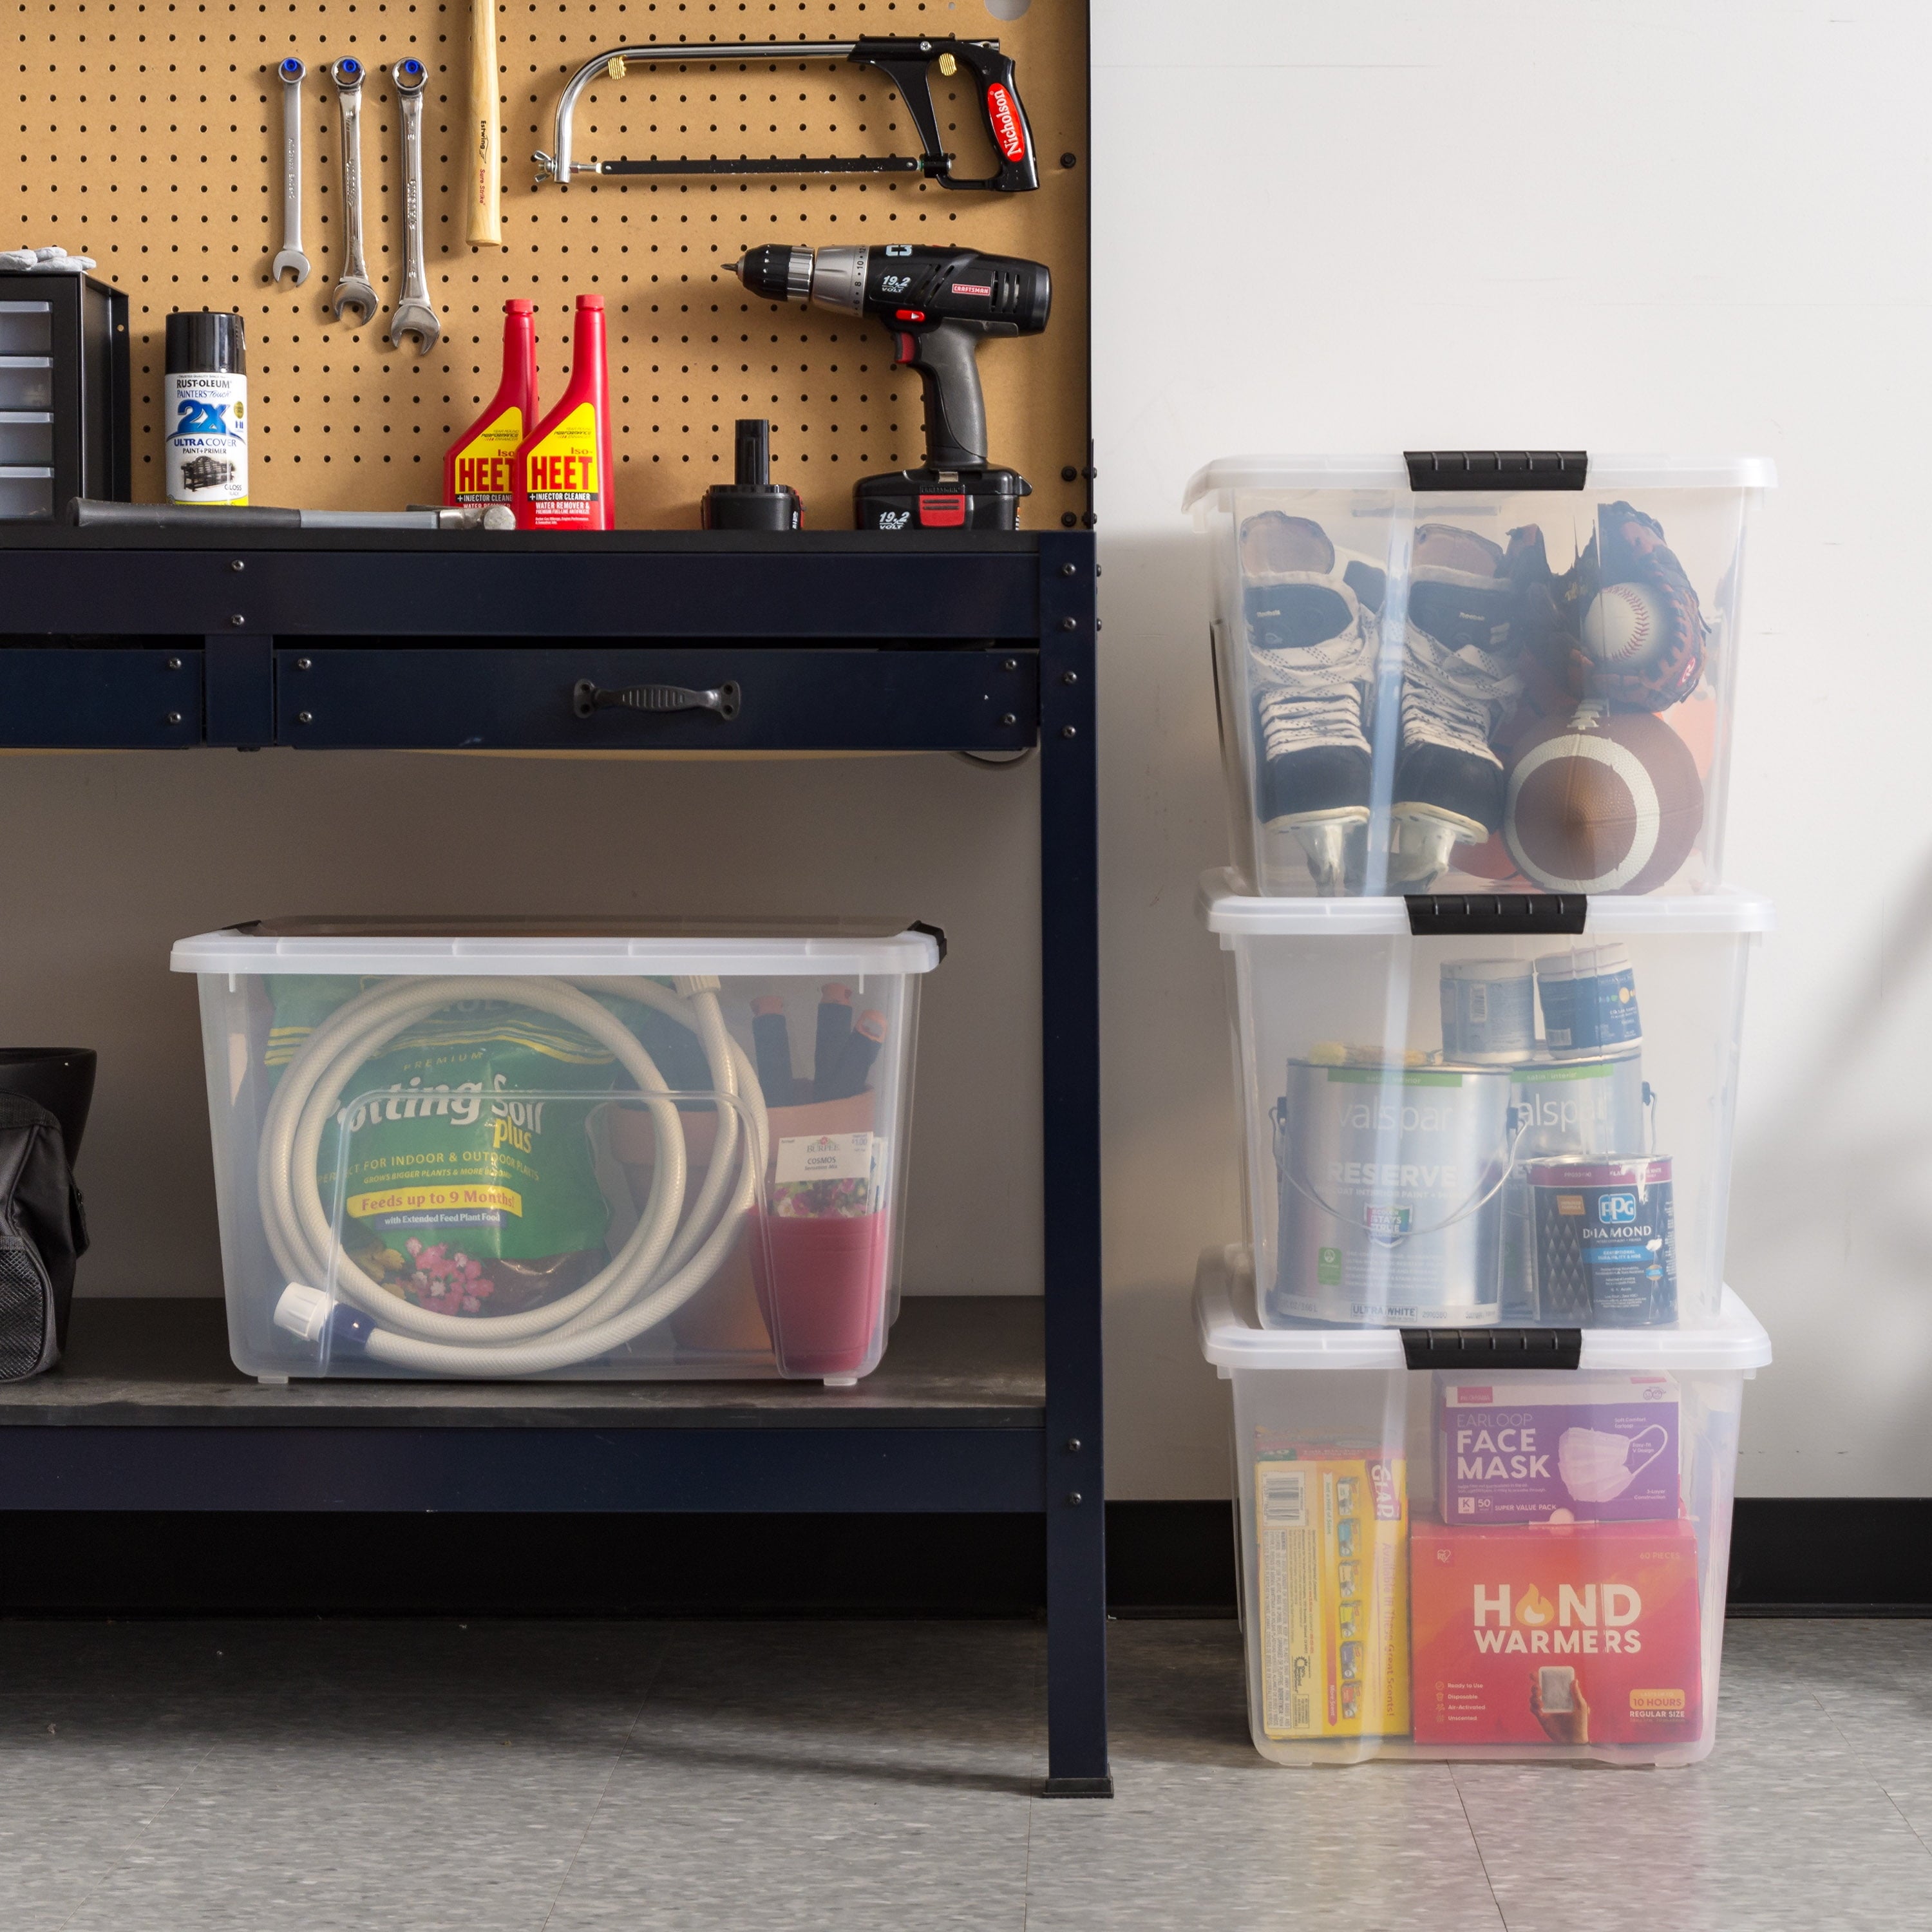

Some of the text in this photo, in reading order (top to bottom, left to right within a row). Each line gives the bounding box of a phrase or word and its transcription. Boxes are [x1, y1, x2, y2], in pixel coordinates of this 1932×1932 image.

[994, 89, 1022, 156] Nicholson
[857, 261, 864, 269] 10
[883, 275, 911, 286] 19.2
[953, 285, 989, 295] CRAFTSMAN
[178, 399, 230, 434] 2X
[531, 456, 592, 490] HEET
[879, 512, 910, 523] 19.2
[404, 1051, 483, 1071] PREMIUM
[327, 1077, 482, 1132] otting
[1337, 1095, 1453, 1140] valspar
[493, 1116, 532, 1153] plus
[363, 1174, 391, 1184] GROWS
[392, 1171, 419, 1180] BIGGER
[421, 1169, 451, 1177] PLANTS
[364, 1159, 386, 1172] FOR
[391, 1153, 444, 1166] INDOOR
[449, 1152, 458, 1162] &
[462, 1151, 516, 1169] OUTDOOR
[516, 1162, 540, 1181] PLANTS
[1327, 1161, 1457, 1187] RESERVE
[362, 1190, 515, 1211] Feeds up to 9 Months!
[1602, 1197, 1634, 1220] PPG
[384, 1212, 501, 1225] with Extended Feed Plant Food
[1583, 1226, 1652, 1238] DIAMOND
[1353, 1305, 1416, 1316] ULTRA WHITE
[1457, 1413, 1533, 1428] EARLOOP
[1457, 1428, 1537, 1454] FACE
[1457, 1455, 1551, 1480] MASK
[1478, 1499, 1491, 1508] 50
[1640, 1551, 1681, 1560] 60 PIECES
[1382, 1543, 1392, 1592] Available
[1387, 1678, 1395, 1716] Scents!
[1473, 1629, 1642, 1654] WARMERS
